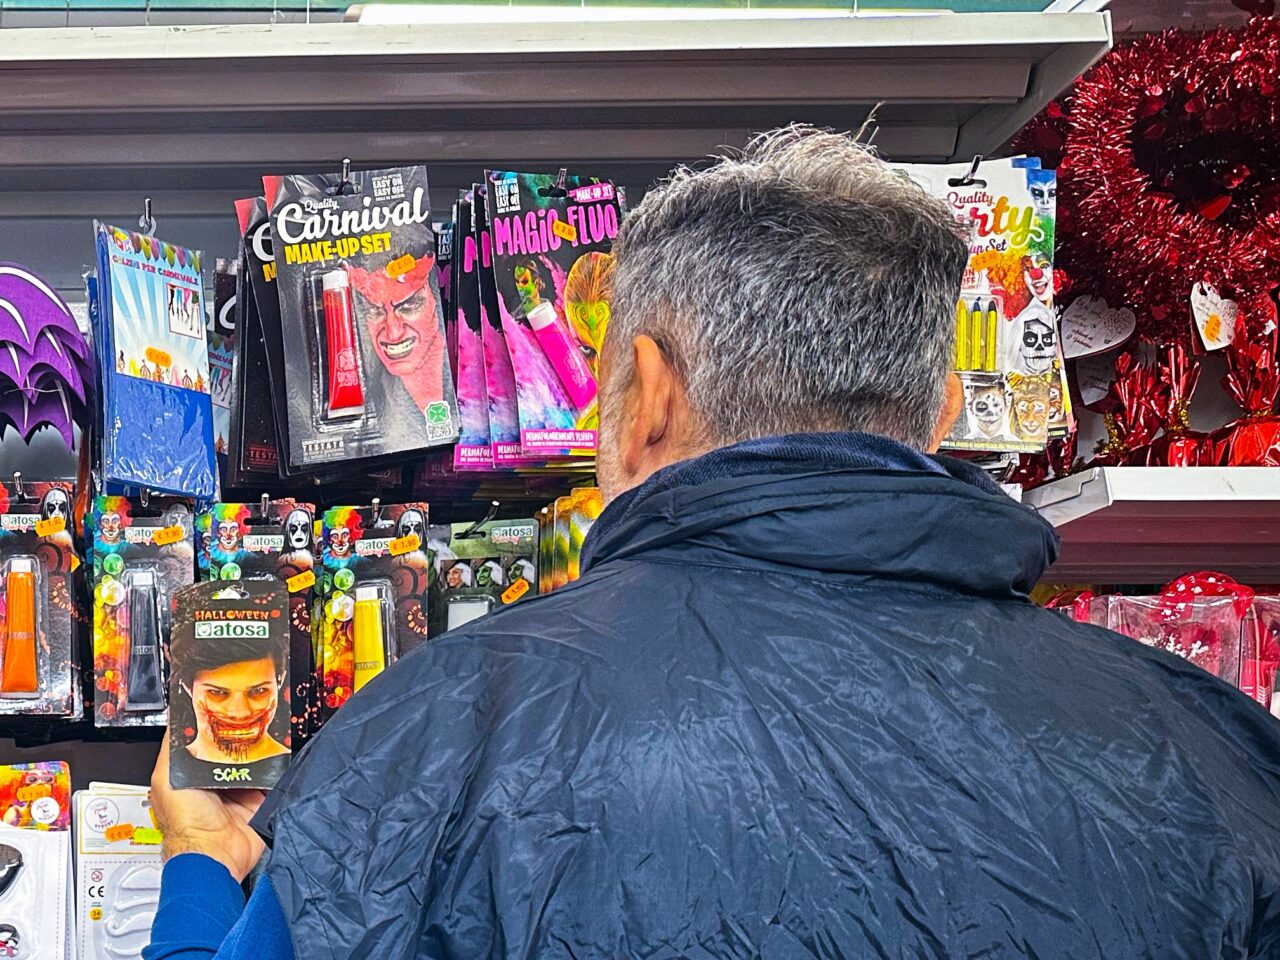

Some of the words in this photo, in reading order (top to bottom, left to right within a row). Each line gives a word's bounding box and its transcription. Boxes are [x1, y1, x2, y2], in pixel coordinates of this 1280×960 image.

[373, 180, 391, 189] EASY
[373, 188, 391, 197] EASY
[303, 198, 339, 213] Quality
[946, 191, 995, 210] Quality
[277, 187, 429, 244] Carnival
[968, 196, 1044, 247] rty
[566, 202, 619, 248] FLUO
[284, 236, 355, 265] MAKE-UP
[360, 231, 392, 254] SET
[985, 238, 1007, 253] Set
[302, 439, 344, 452] TESTATO
[194, 610, 270, 621] HALLOWEEN
[213, 622, 268, 637] atosa
[212, 767, 253, 783] SCAR
